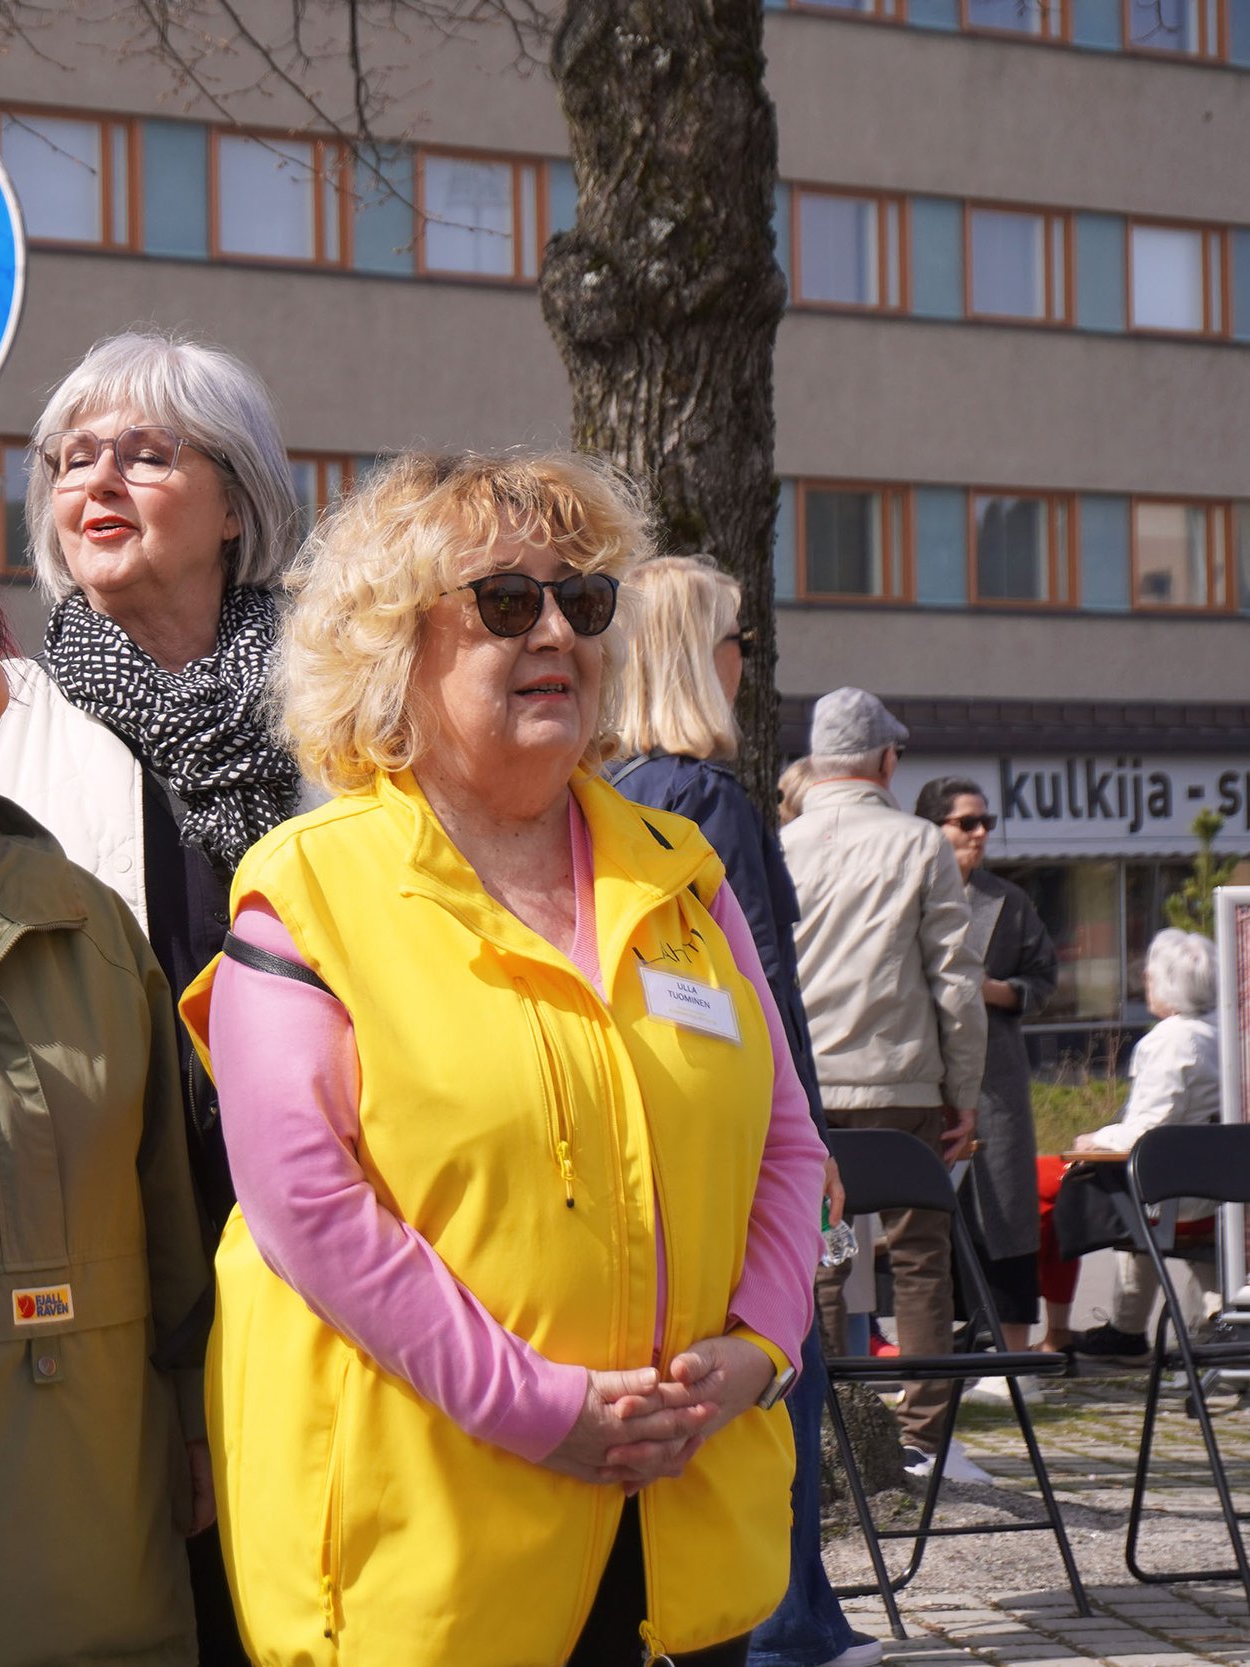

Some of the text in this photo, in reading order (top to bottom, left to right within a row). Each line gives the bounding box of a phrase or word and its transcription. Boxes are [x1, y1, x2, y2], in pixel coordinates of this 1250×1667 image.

[1001, 756, 1172, 833] kulkija
[1218, 769, 1250, 831] s
[677, 982, 698, 995] ULLA
[667, 990, 710, 1009] TUOMINEN
[37, 1303, 68, 1317] RAVEN
